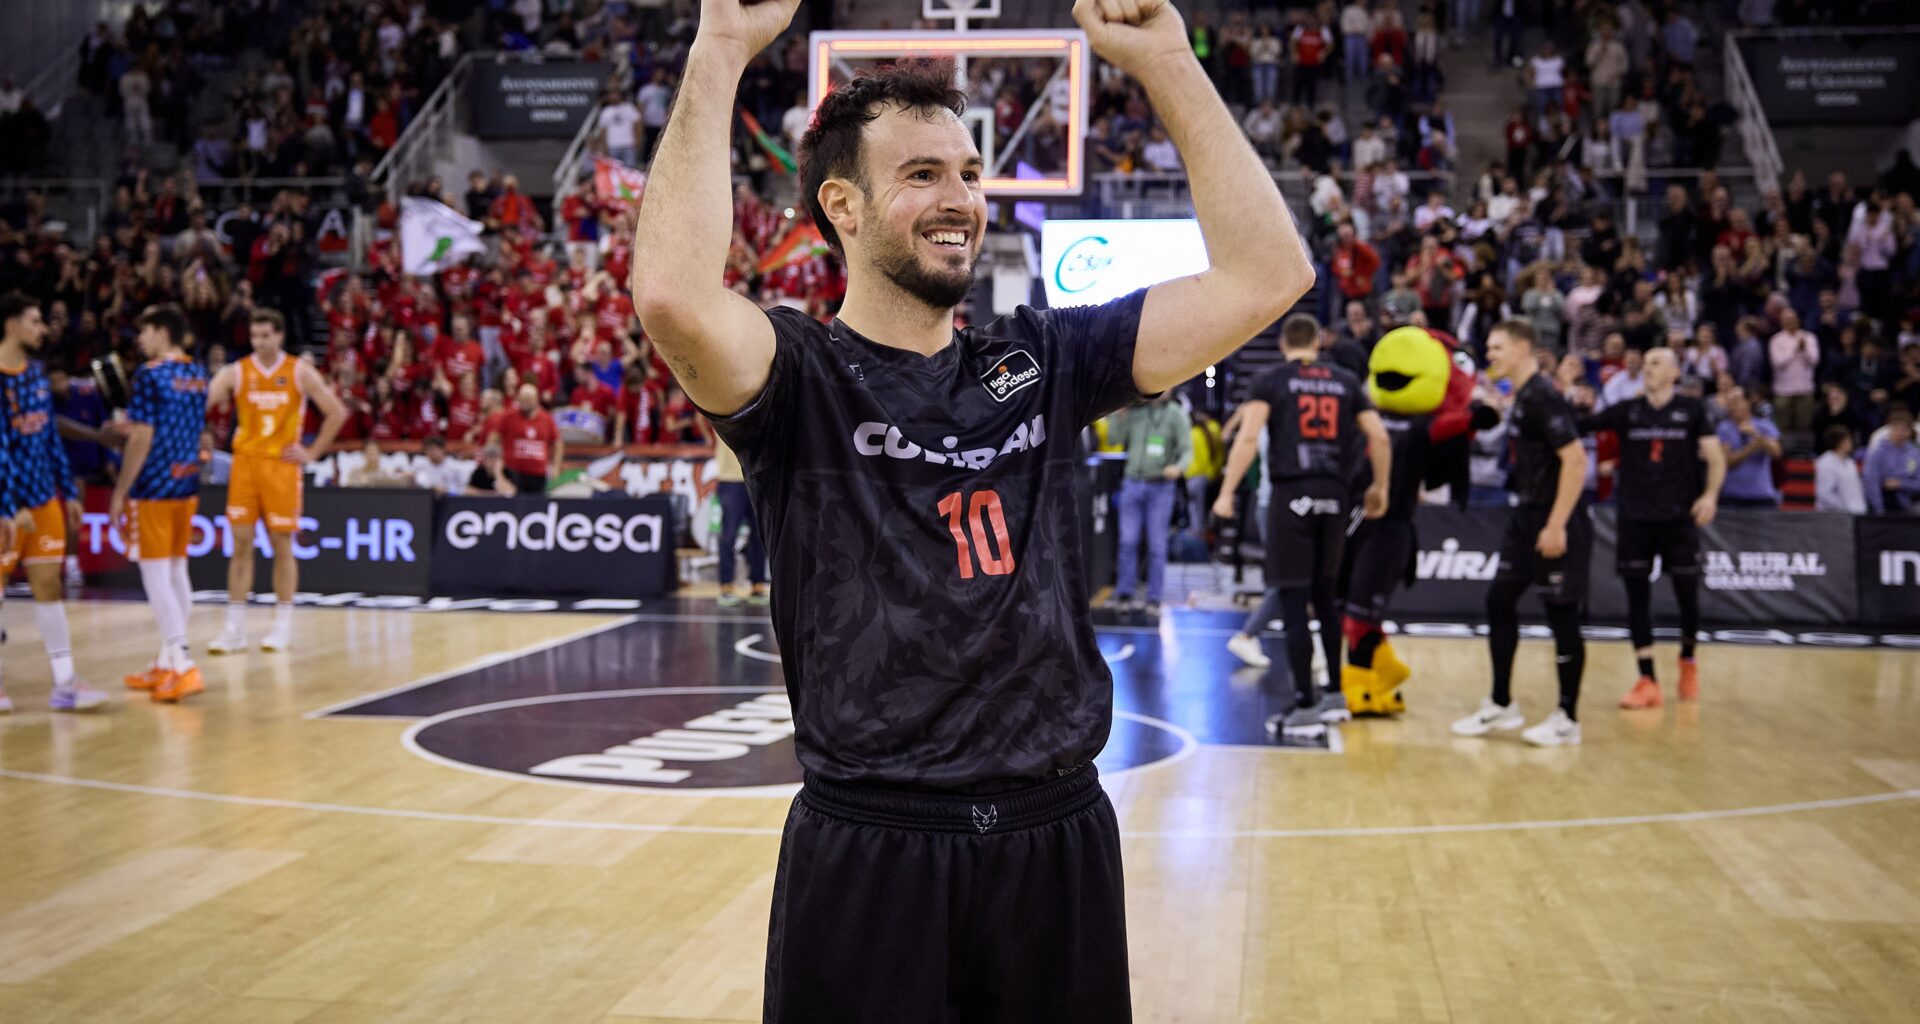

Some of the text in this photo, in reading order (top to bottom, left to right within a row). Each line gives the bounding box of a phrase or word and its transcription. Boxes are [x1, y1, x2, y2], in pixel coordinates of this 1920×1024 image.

[990, 371, 1011, 389] liga
[997, 367, 1038, 395] endesa
[1297, 395, 1339, 439] 29
[445, 501, 663, 552] endesa
[937, 489, 1015, 579] 10
